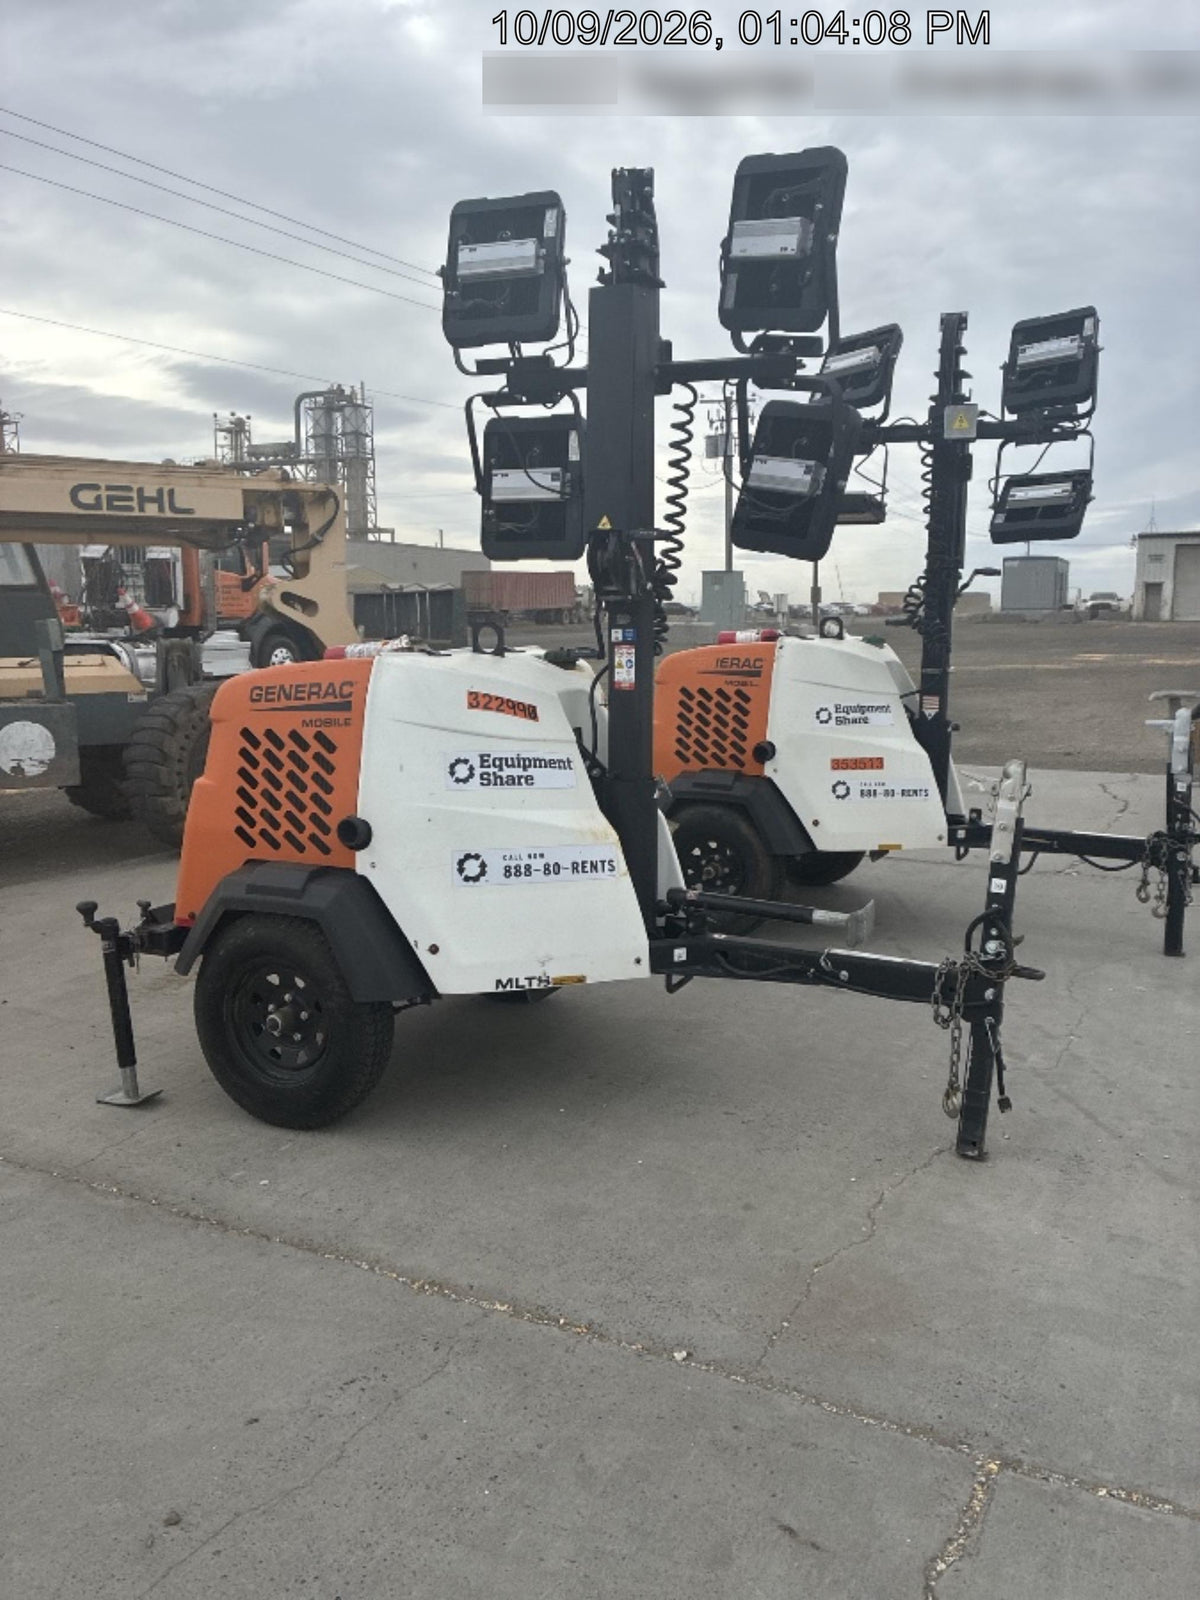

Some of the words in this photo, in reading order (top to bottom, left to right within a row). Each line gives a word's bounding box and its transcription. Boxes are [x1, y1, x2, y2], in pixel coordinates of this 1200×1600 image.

[69, 483, 195, 515] GEHL
[250, 681, 354, 703] GENERAC
[835, 704, 891, 715] Equipment
[302, 718, 352, 728] MOBILE
[835, 717, 869, 726] Share
[479, 753, 573, 772] Equipment
[480, 771, 534, 787] Share
[503, 860, 616, 879] 888-80-RENTS
